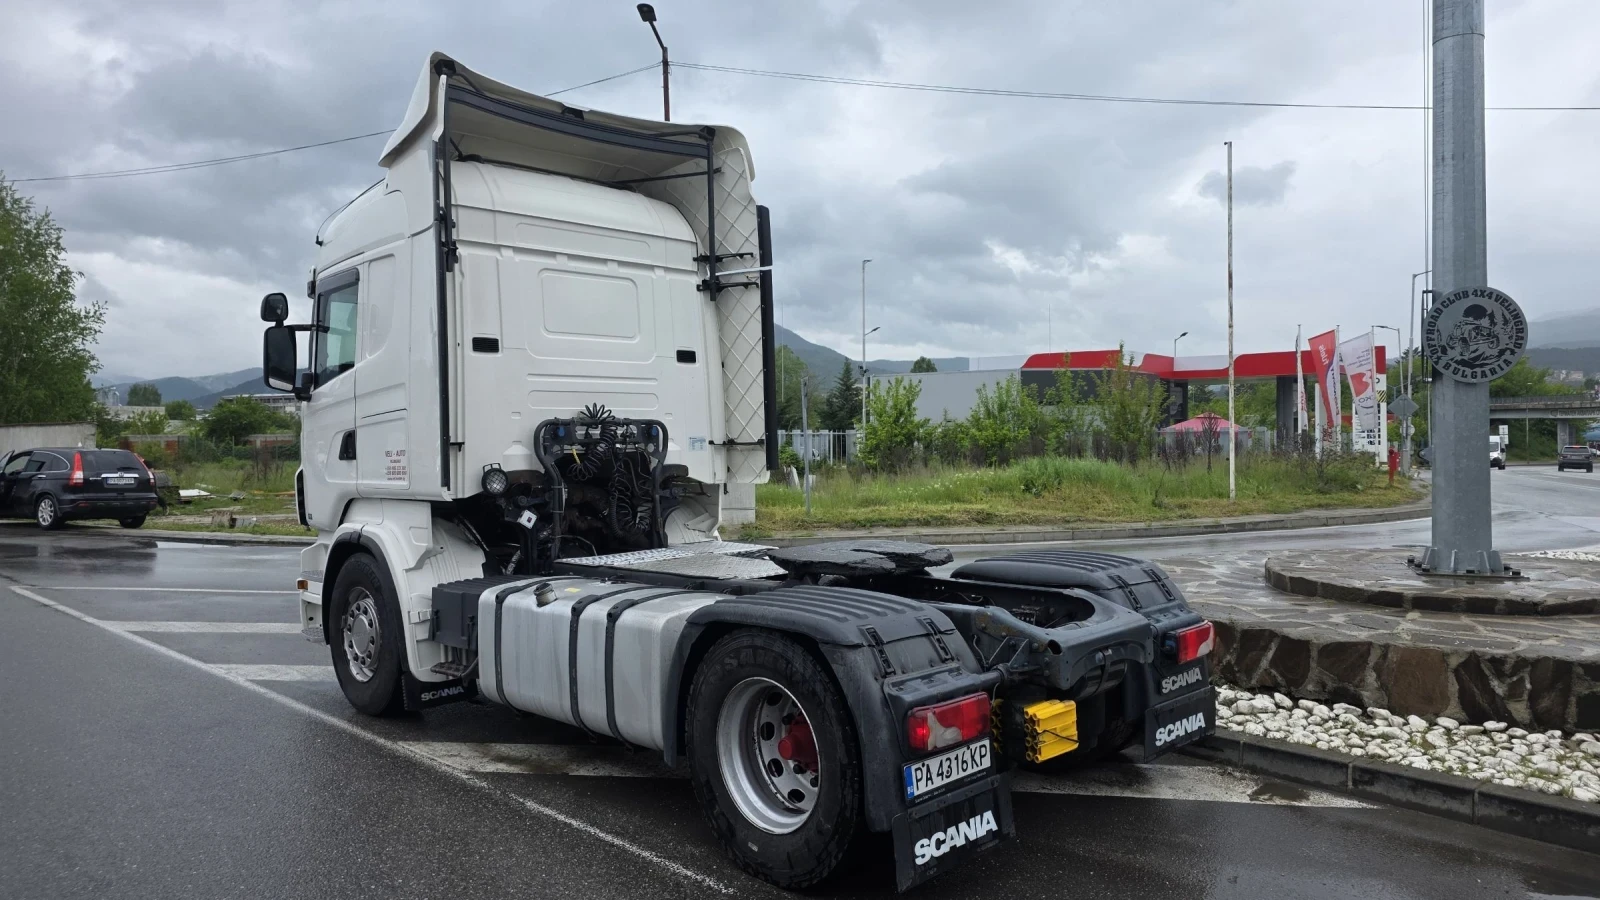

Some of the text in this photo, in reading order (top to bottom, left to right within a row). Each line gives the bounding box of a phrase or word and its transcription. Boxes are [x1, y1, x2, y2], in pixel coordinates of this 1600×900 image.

[1426, 289, 1525, 356] OFFROAD CLUB 4X4 VELINGRAD
[1442, 358, 1513, 380] BULGARIA
[420, 685, 465, 701] SCANIA
[1161, 667, 1203, 694] SCANIA
[1155, 712, 1206, 747] SCANIA
[914, 809, 999, 866] SCANIA
